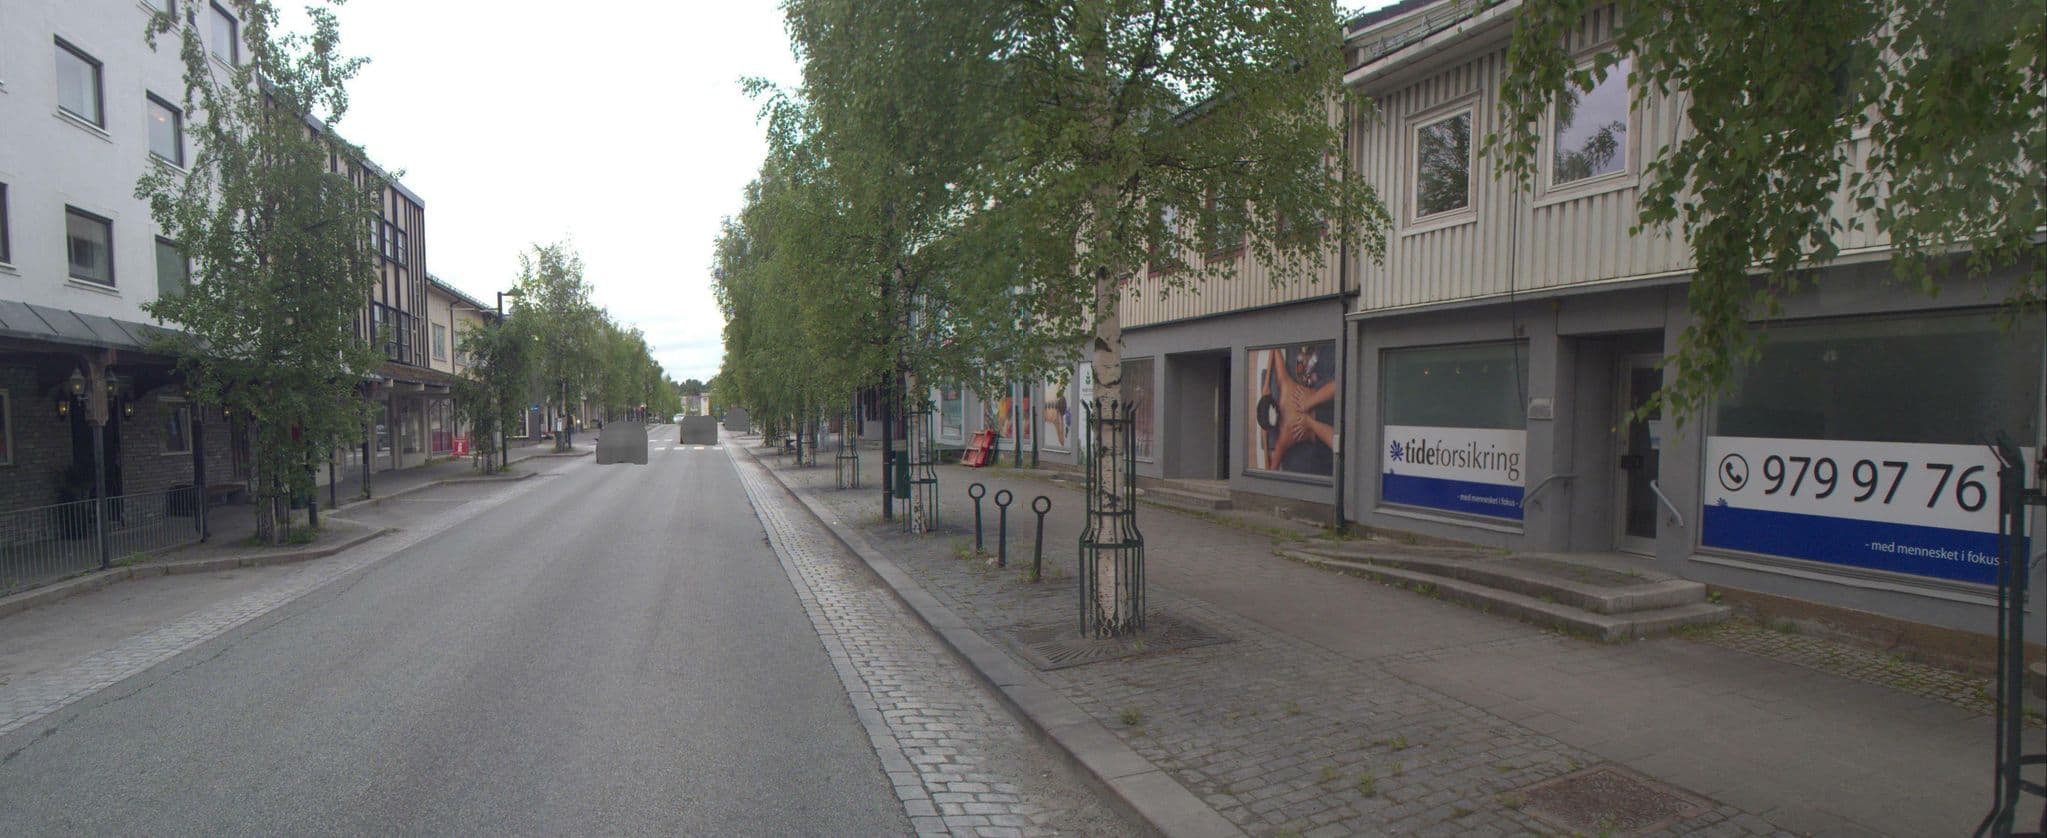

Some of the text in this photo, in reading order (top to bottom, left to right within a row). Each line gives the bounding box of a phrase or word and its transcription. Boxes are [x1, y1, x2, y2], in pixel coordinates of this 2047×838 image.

[1405, 438, 1521, 482] tideforsikring
[1762, 454, 2000, 513] 979 97 76
[1871, 541, 1895, 553] med
[1897, 544, 1959, 561] mennesket
[1961, 550, 1965, 561] i
[1967, 551, 2000, 567] fokus
